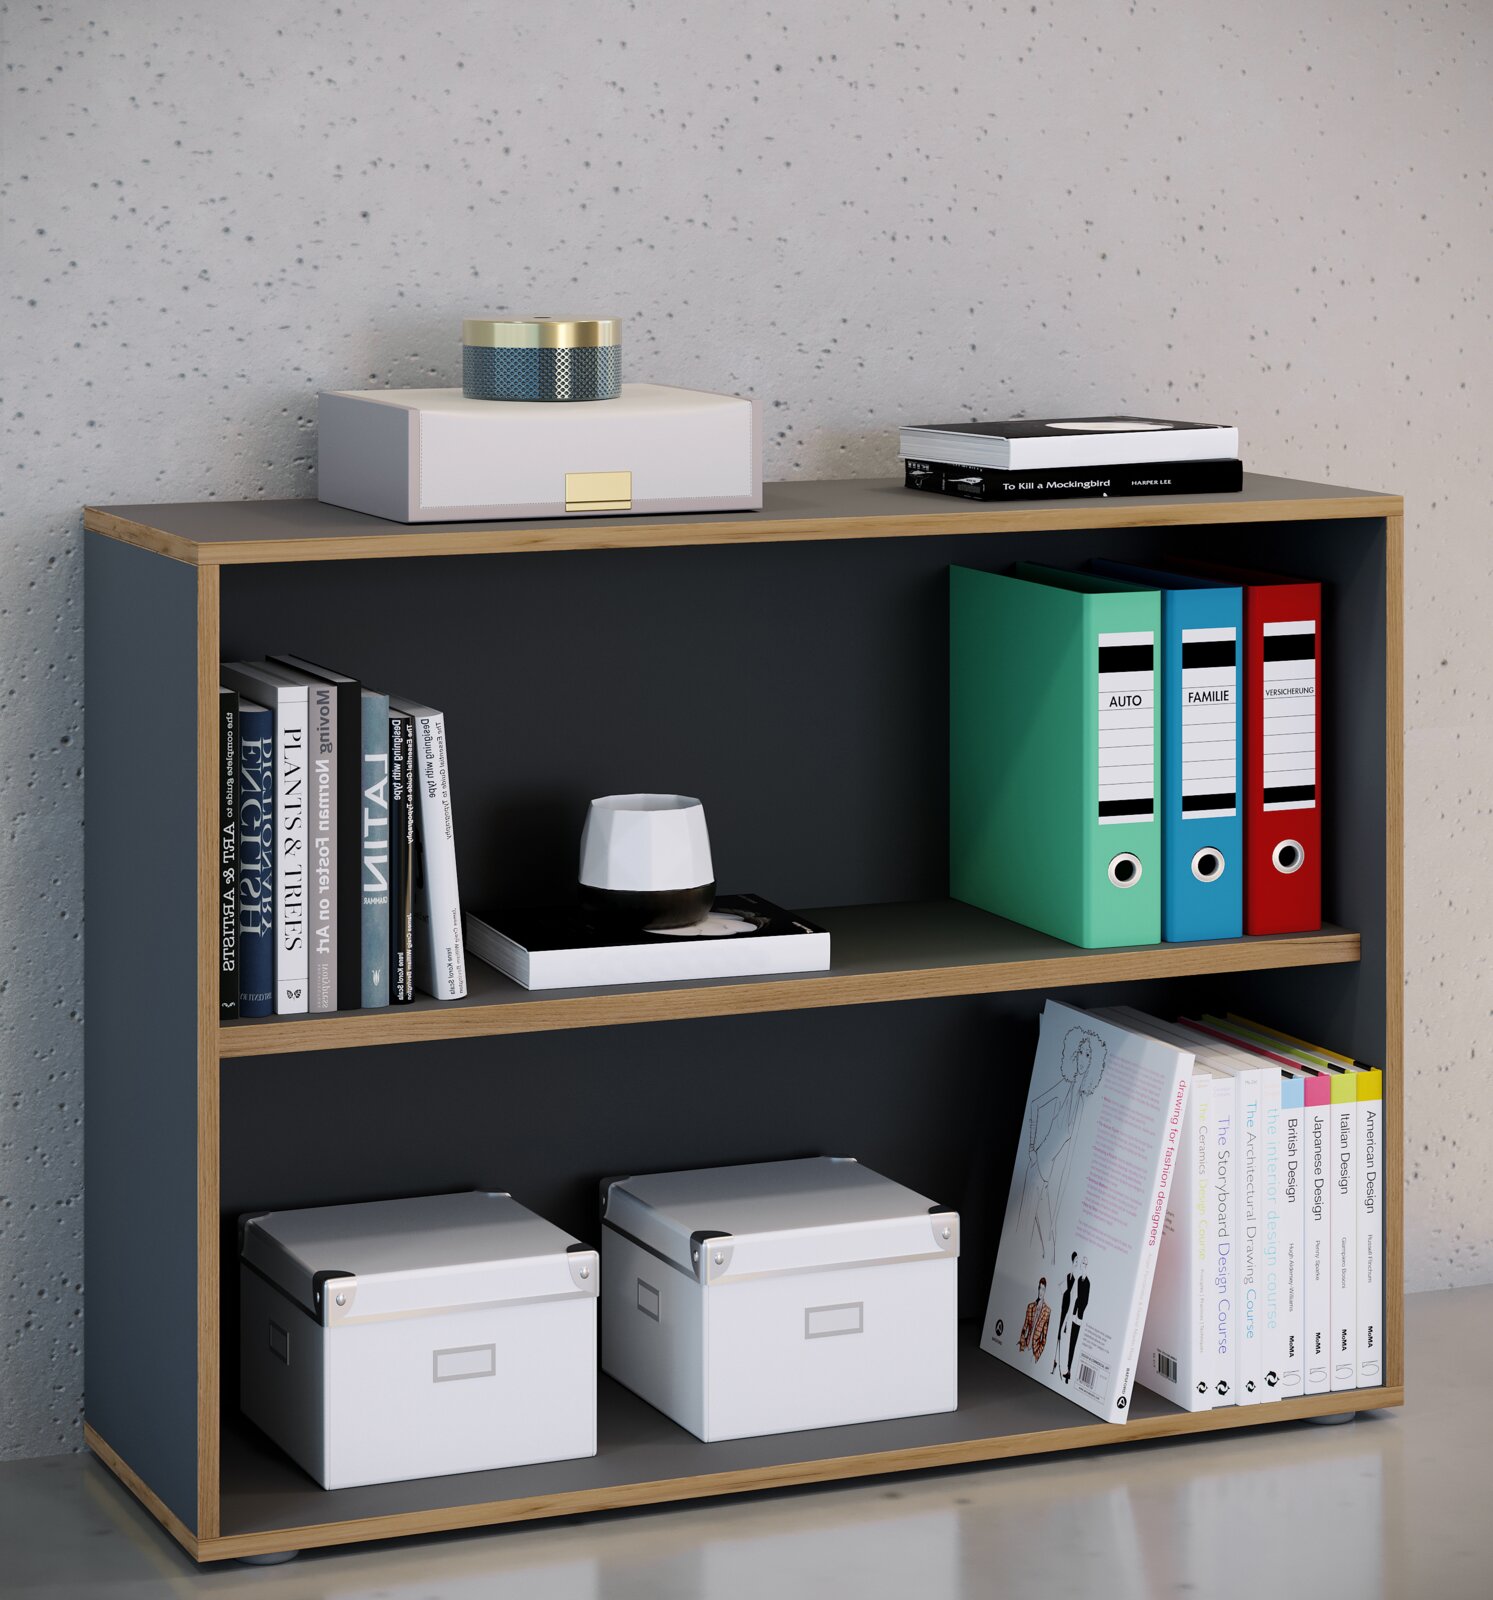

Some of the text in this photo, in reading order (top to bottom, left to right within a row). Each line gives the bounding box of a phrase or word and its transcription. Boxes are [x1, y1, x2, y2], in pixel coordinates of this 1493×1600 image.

[1003, 482, 1016, 490] To
[1019, 481, 1034, 490] Kill
[1046, 479, 1110, 490] Mockingbird
[1109, 695, 1142, 707] AUTO
[1188, 690, 1229, 703] FAMILIE
[1265, 687, 1314, 696] VERSICHERUNG
[284, 728, 302, 951] PLANTS & TREES
[1247, 1101, 1257, 1127] The
[1267, 1109, 1280, 1134] the
[1148, 1080, 1187, 1246] drawing for fashion designers
[1198, 1126, 1208, 1175] Ceramics
[1246, 1132, 1257, 1220] Architectural
[1267, 1142, 1280, 1202] interior
[1286, 1119, 1298, 1203] British Design
[1312, 1116, 1324, 1221] Japanese Design
[1338, 1113, 1350, 1195] Italian Design
[1365, 1110, 1376, 1214] American Design
[1199, 1219, 1208, 1260] Course
[1215, 1115, 1230, 1354] The Storyboard Design Course
[1244, 1226, 1257, 1284] Drawing
[1264, 1211, 1280, 1266] design
[1246, 1289, 1257, 1339] Course
[1267, 1273, 1278, 1329] course
